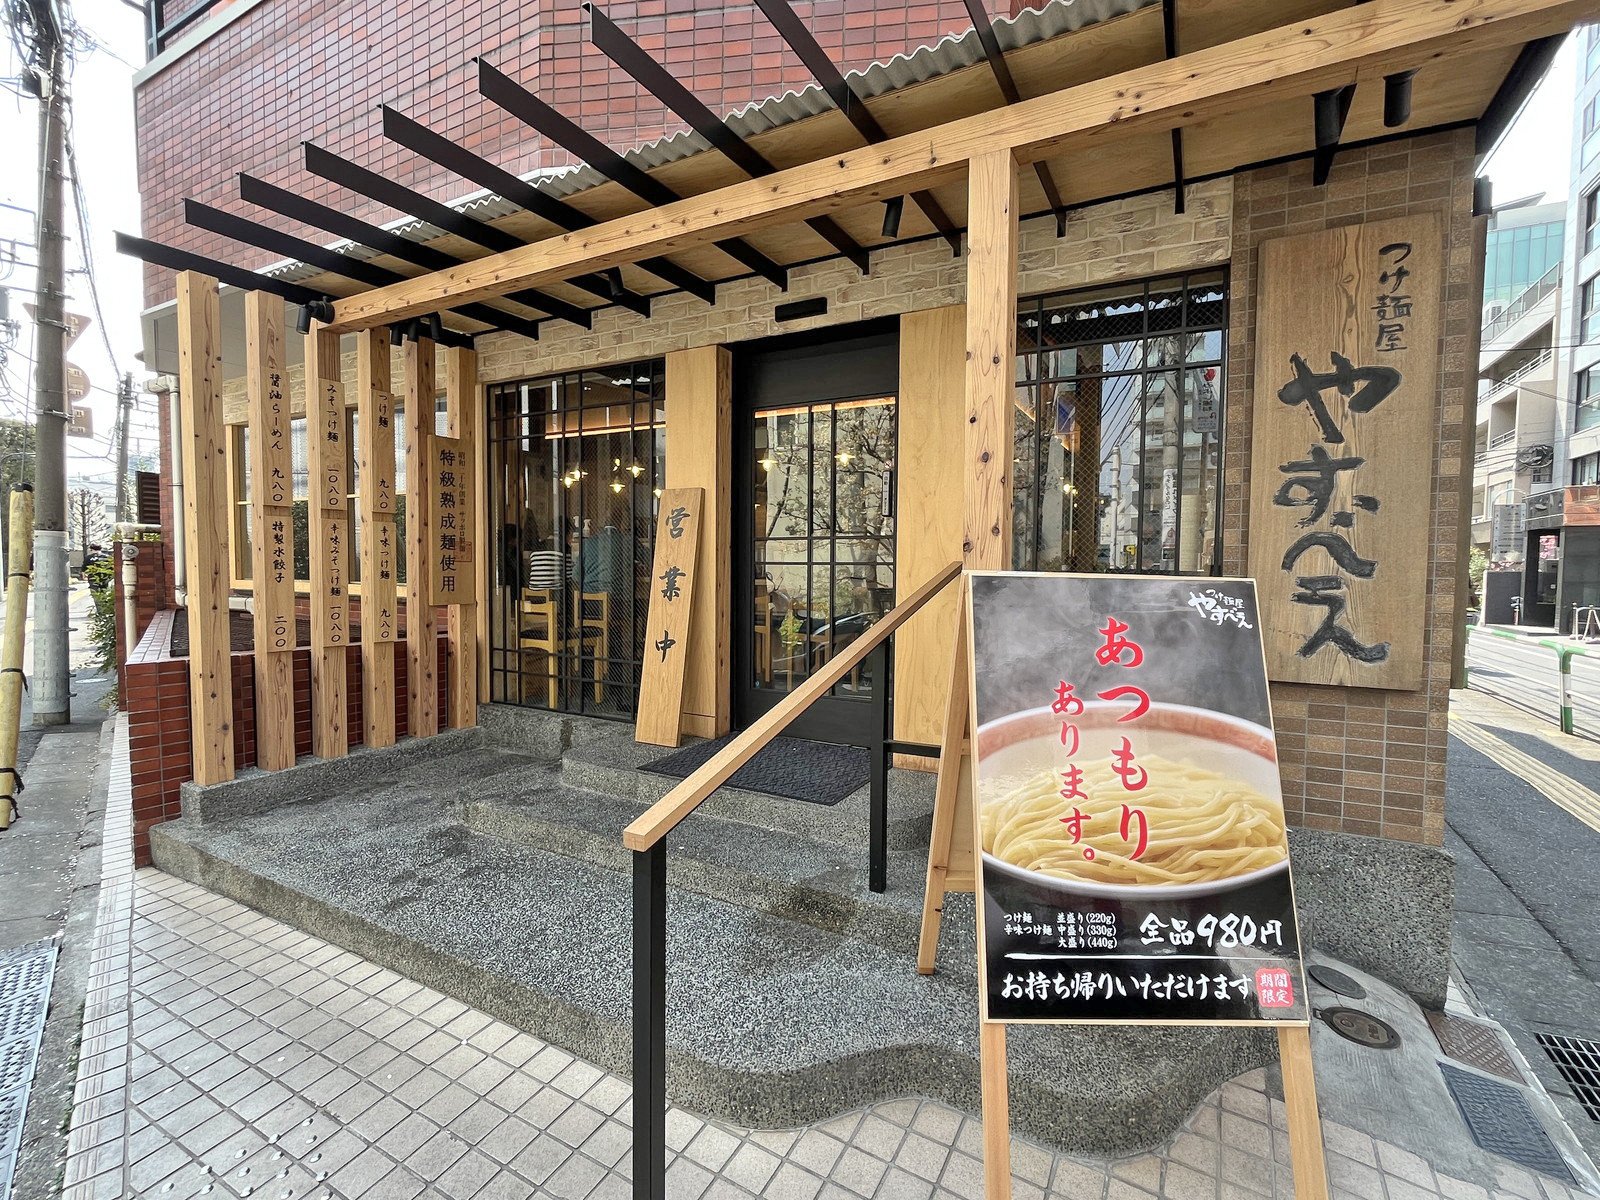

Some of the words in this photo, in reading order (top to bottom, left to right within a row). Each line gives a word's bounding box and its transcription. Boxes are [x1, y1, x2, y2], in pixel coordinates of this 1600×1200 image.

[1371, 241, 1413, 354] つけ麺屋
[269, 373, 283, 450] 醤油らーめん
[326, 384, 339, 442] みそつけ麺
[378, 394, 389, 428] つけ麺
[439, 448, 457, 593] 特級熟成麺使用
[1272, 349, 1404, 666] やすべえ
[271, 520, 286, 584] 特製水餃子
[330, 523, 341, 597] 辛味みそつけ麺
[380, 525, 391, 580] 辛味つけ麺
[655, 506, 691, 663] 営業中
[1188, 591, 1253, 629] やすべえ
[1095, 617, 1151, 861] あつもり
[1051, 680, 1096, 861] あります。
[1003, 911, 1033, 924] つけ麺
[1003, 923, 1053, 936] 辛味つけ麺
[1139, 912, 1283, 948] 全品980円
[1001, 971, 1252, 1001] お持ち帰りいただけます
[1259, 972, 1288, 988] 期間
[1261, 989, 1289, 1005] 限定
